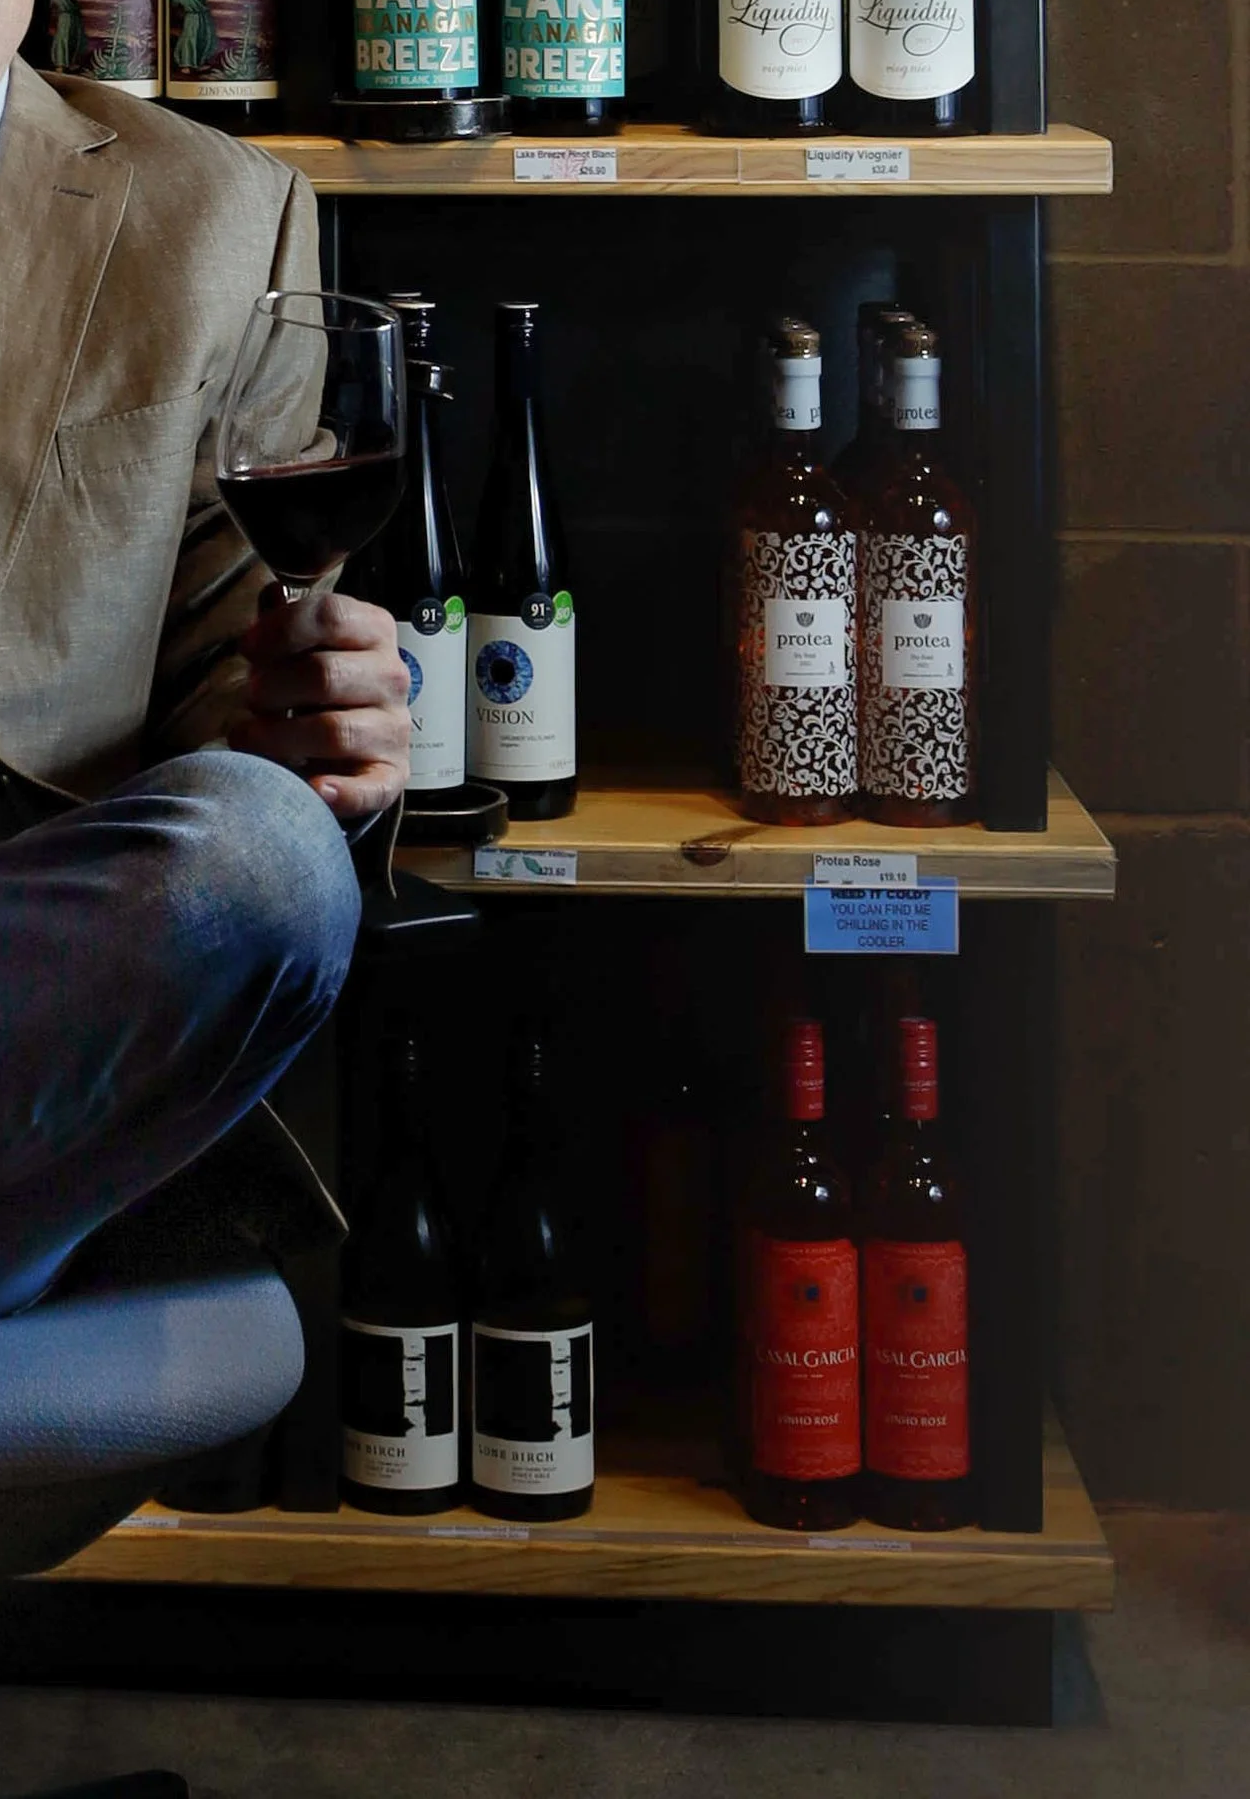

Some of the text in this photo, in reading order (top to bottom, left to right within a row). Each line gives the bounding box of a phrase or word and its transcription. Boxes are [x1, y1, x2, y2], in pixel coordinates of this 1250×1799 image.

[355, 37, 477, 72] BREEZE
[504, 47, 623, 82] BREEZE
[374, 75, 430, 85] PINOT BLANC
[522, 83, 579, 93] PINOT BLANC
[516, 150, 535, 159] Lake
[537, 150, 566, 159] Breeze
[592, 150, 615, 159] Blanc
[807, 150, 902, 163] Liquidity Viognier
[422, 608, 437, 622] 91
[531, 603, 546, 616] 91
[776, 632, 833, 649] protea
[894, 634, 951, 650] protea
[476, 707, 534, 725] VISION
[815, 855, 881, 867] Protea Rose
[831, 889, 931, 900] NEED IT COLD?
[830, 903, 931, 915] YOU CAN FIND ME
[836, 919, 929, 931] CHILLING IN THE
[858, 935, 905, 947] COOLER
[365, 1444, 406, 1458] BIRCH
[511, 1451, 554, 1462] BIRCH
